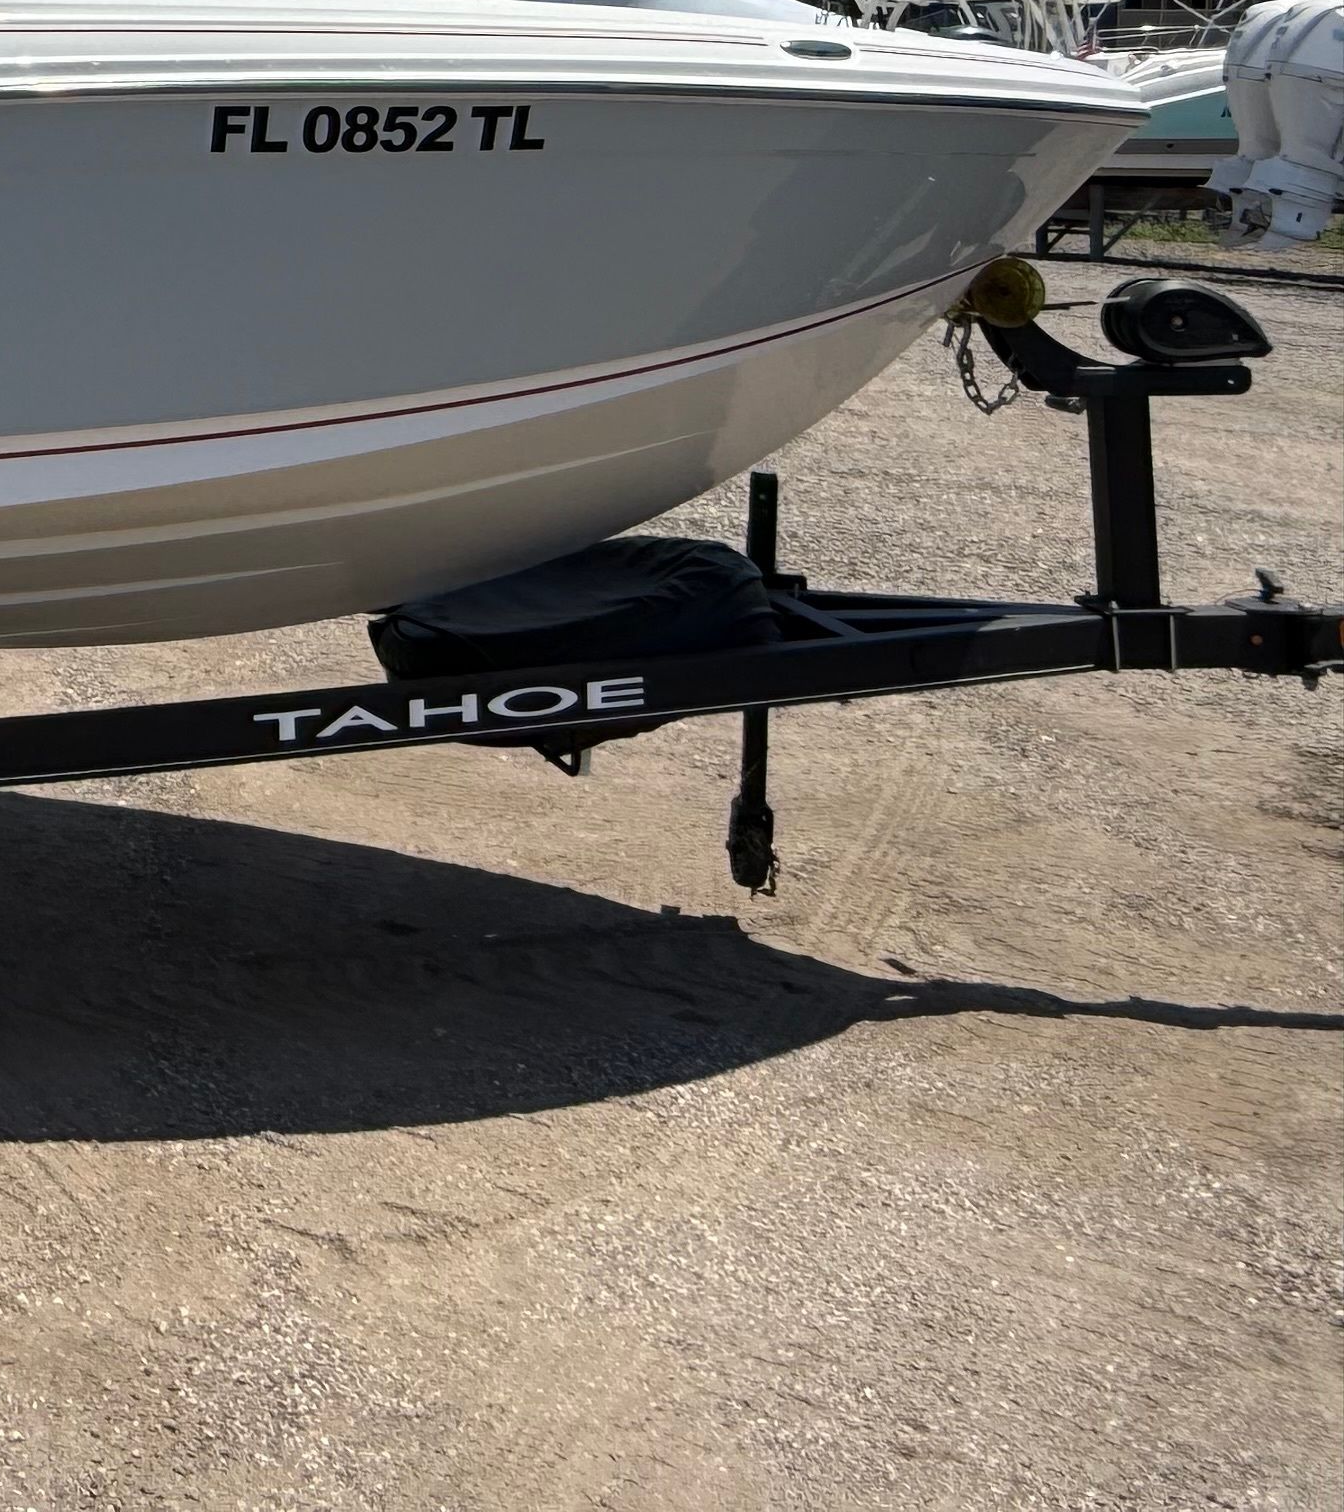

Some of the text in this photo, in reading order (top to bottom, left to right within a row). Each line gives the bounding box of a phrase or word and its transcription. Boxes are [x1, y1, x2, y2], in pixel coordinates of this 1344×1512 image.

[209, 104, 546, 154] FL 0852 TL
[252, 676, 645, 742] TAHOE
